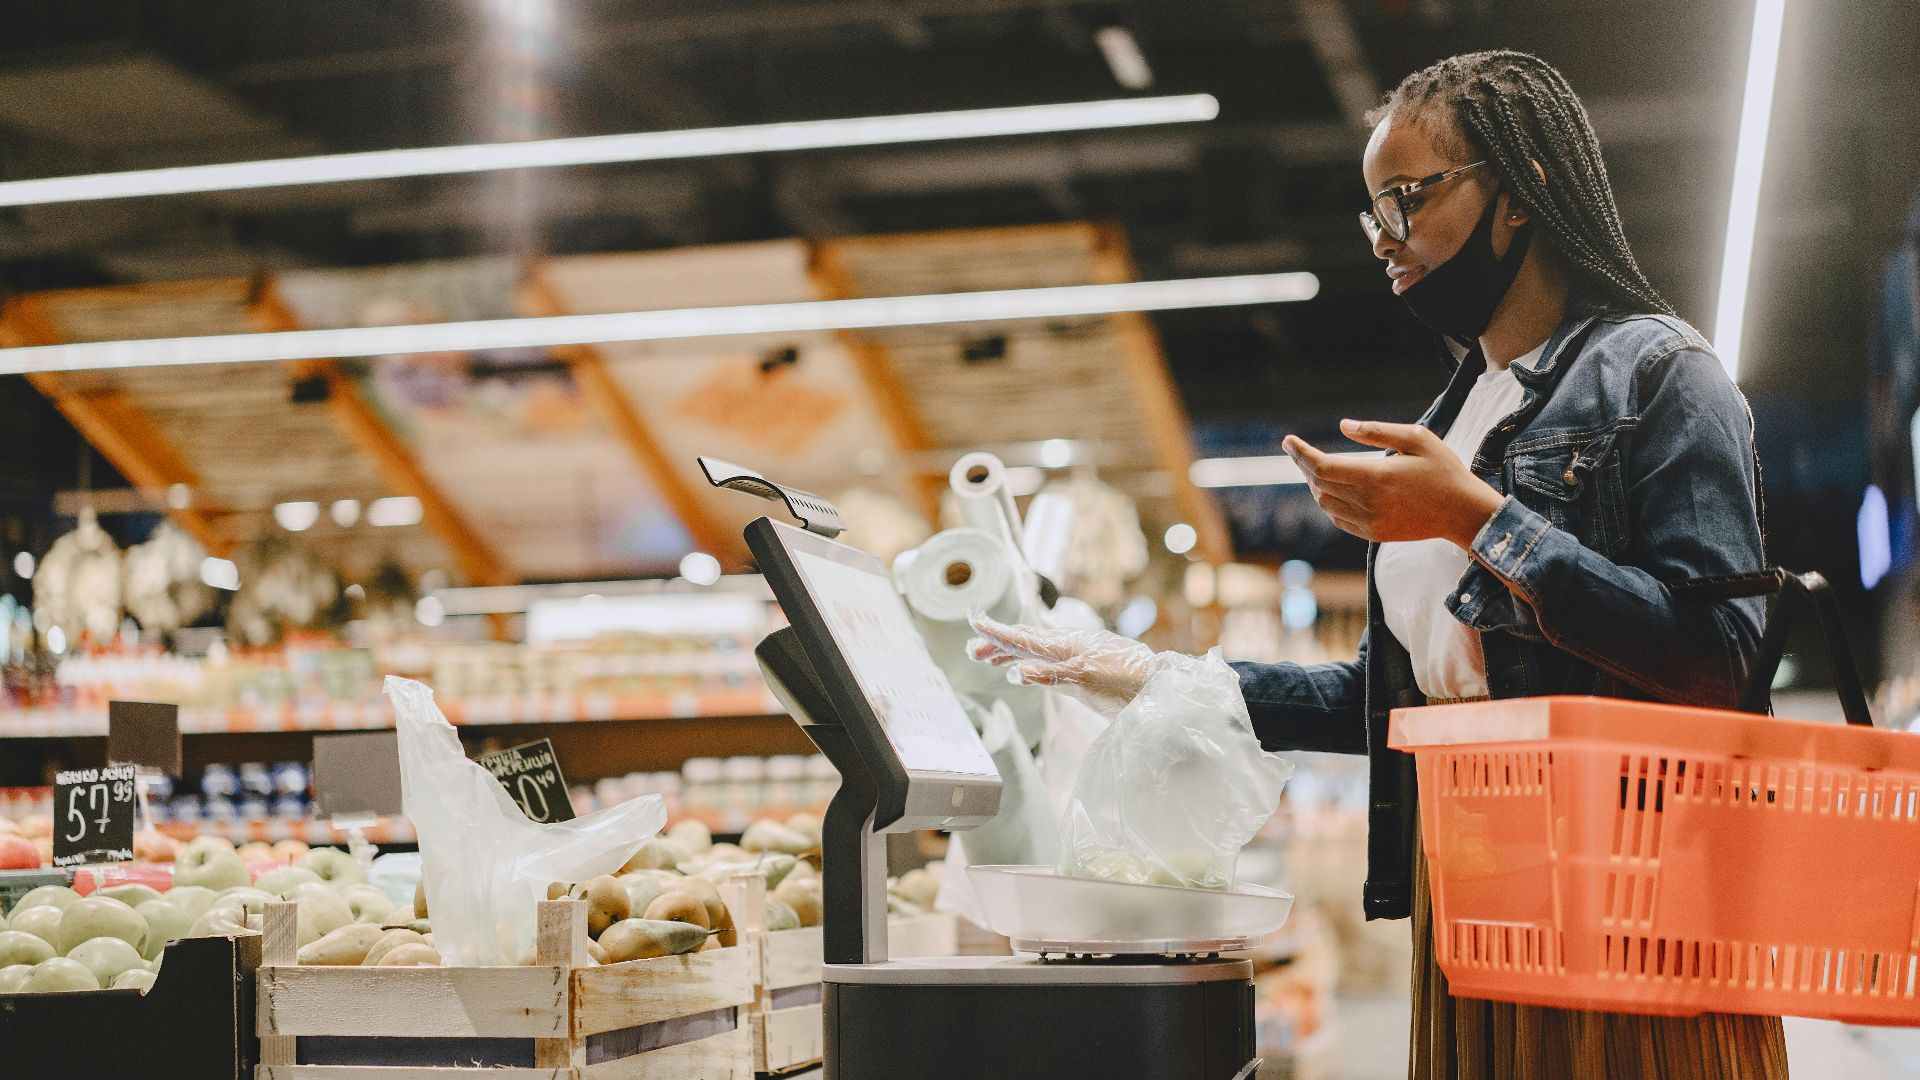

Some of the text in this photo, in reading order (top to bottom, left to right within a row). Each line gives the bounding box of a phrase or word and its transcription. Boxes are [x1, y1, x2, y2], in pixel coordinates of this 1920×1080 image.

[536, 769, 556, 788] 49
[66, 780, 133, 842] 57 99
